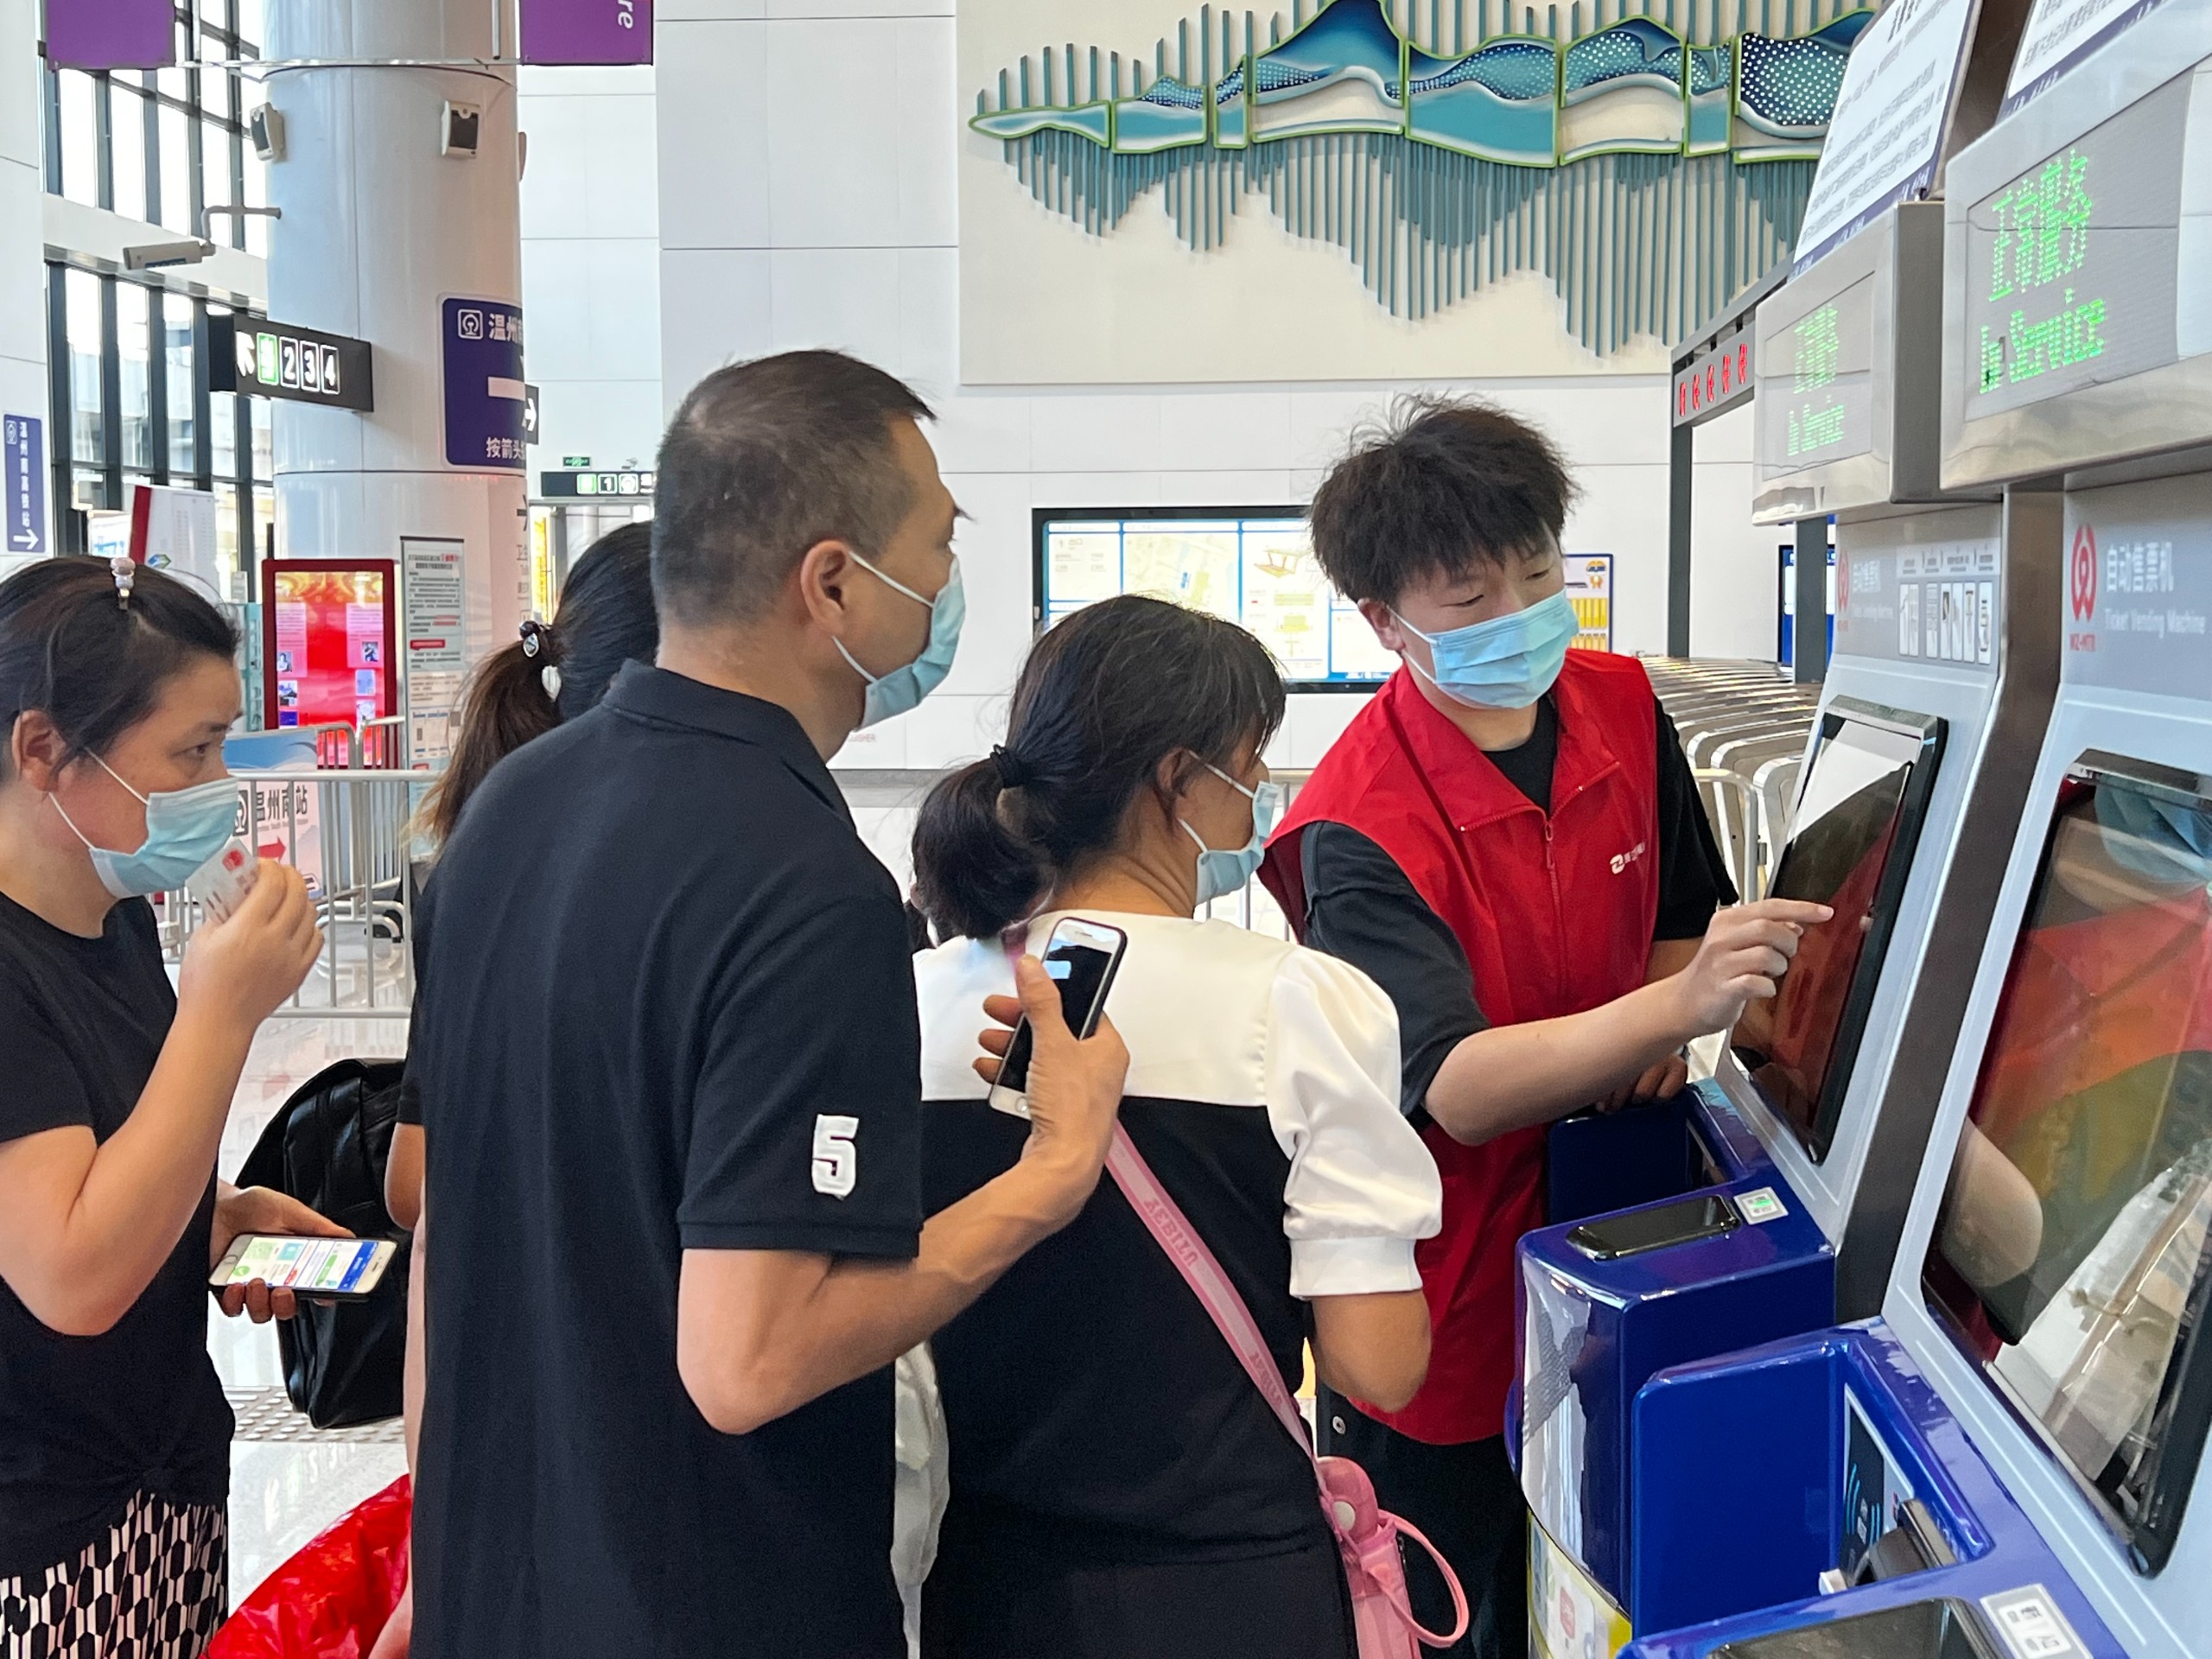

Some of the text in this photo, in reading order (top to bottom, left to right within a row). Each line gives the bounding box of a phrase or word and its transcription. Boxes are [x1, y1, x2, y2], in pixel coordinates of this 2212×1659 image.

[283, 346, 296, 380] 2
[304, 350, 315, 384] 3
[325, 354, 335, 386] 4
[2010, 287, 2106, 383] Service
[2107, 542, 2174, 593] 自动售票机
[811, 1114, 859, 1197] 5
